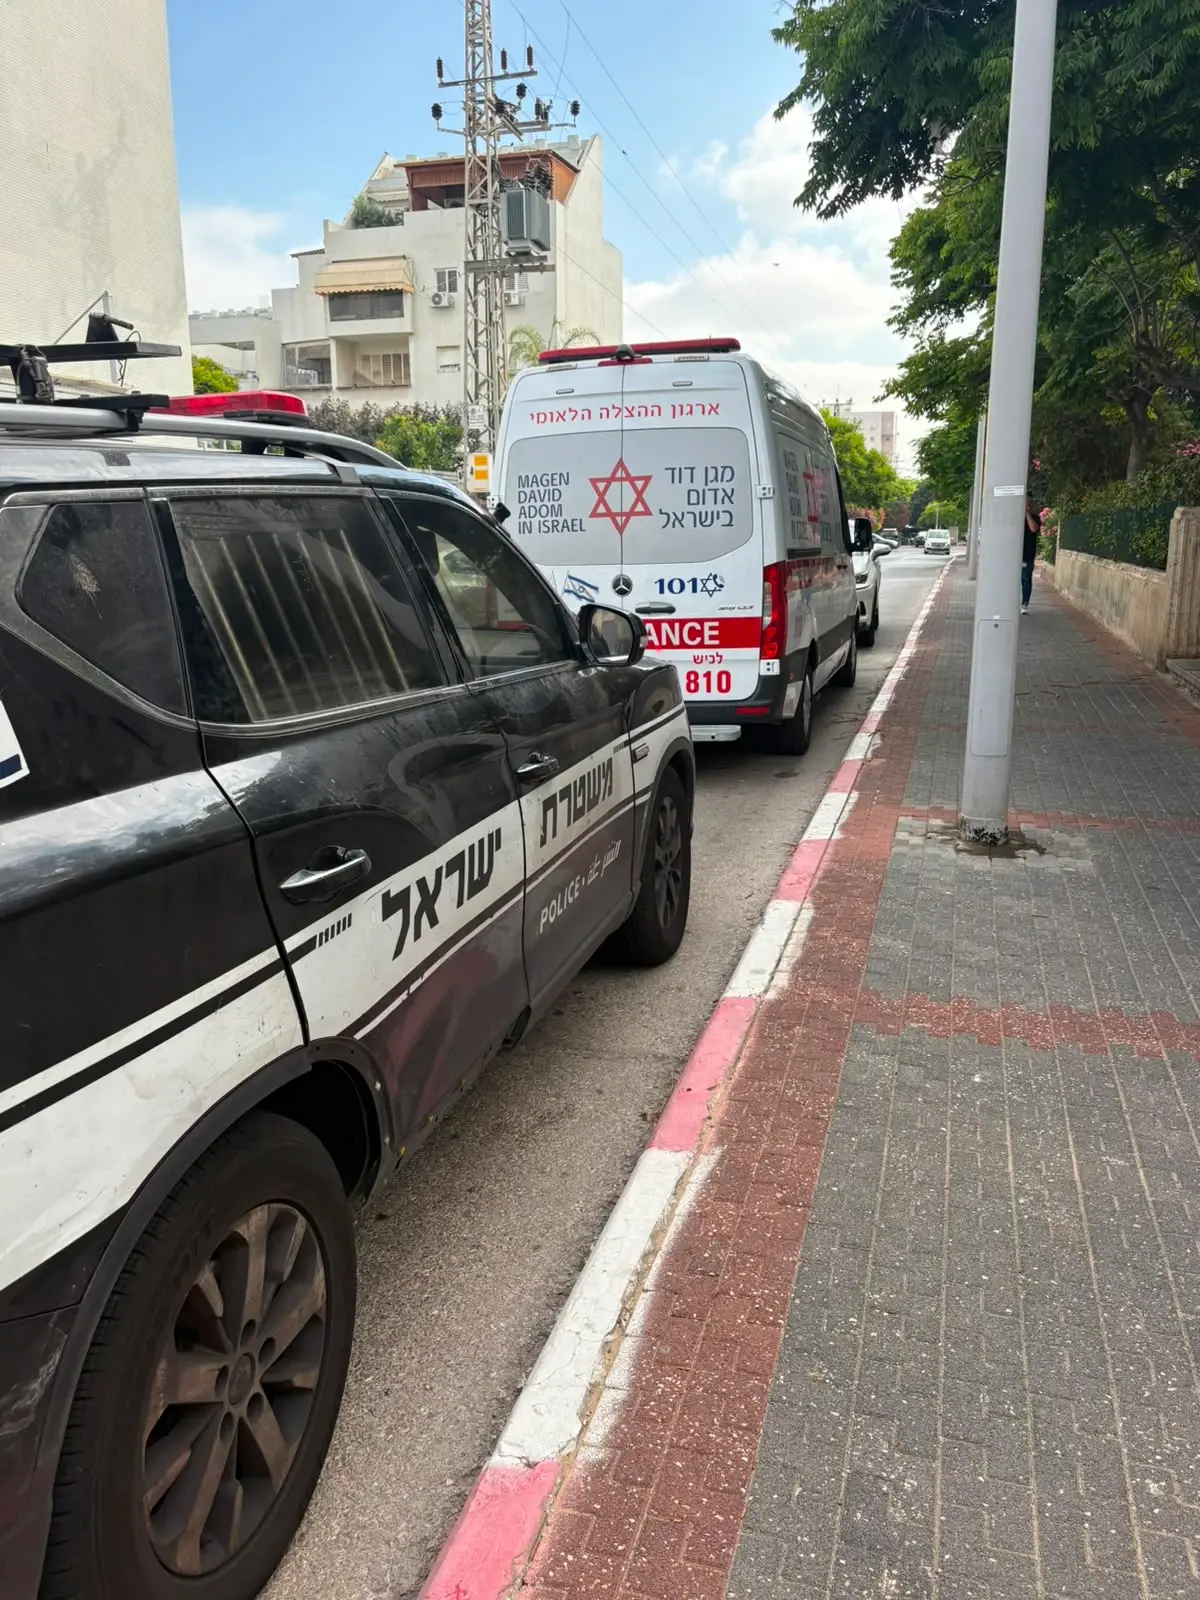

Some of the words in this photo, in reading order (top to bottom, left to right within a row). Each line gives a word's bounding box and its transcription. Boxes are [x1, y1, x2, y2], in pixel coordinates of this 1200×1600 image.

[529, 406, 592, 424] הלאומי
[599, 403, 662, 420] ההצלה
[670, 402, 720, 419] ארגון
[517, 471, 570, 489] MAGEN
[664, 466, 697, 484] דוד
[704, 465, 735, 487] מגן
[517, 488, 562, 504] DAVID
[687, 487, 735, 506] אדום
[518, 503, 563, 519] ADOM
[659, 508, 735, 530] בישראל
[518, 520, 533, 535] IN
[537, 518, 587, 534] ISRAEL
[653, 577, 698, 595] 101
[644, 621, 720, 647] ANCE
[692, 652, 724, 664] לכיש
[685, 670, 732, 694] 810
[539, 757, 613, 849] משטרת
[381, 827, 502, 961] ישראל
[540, 875, 581, 934] POLICE
